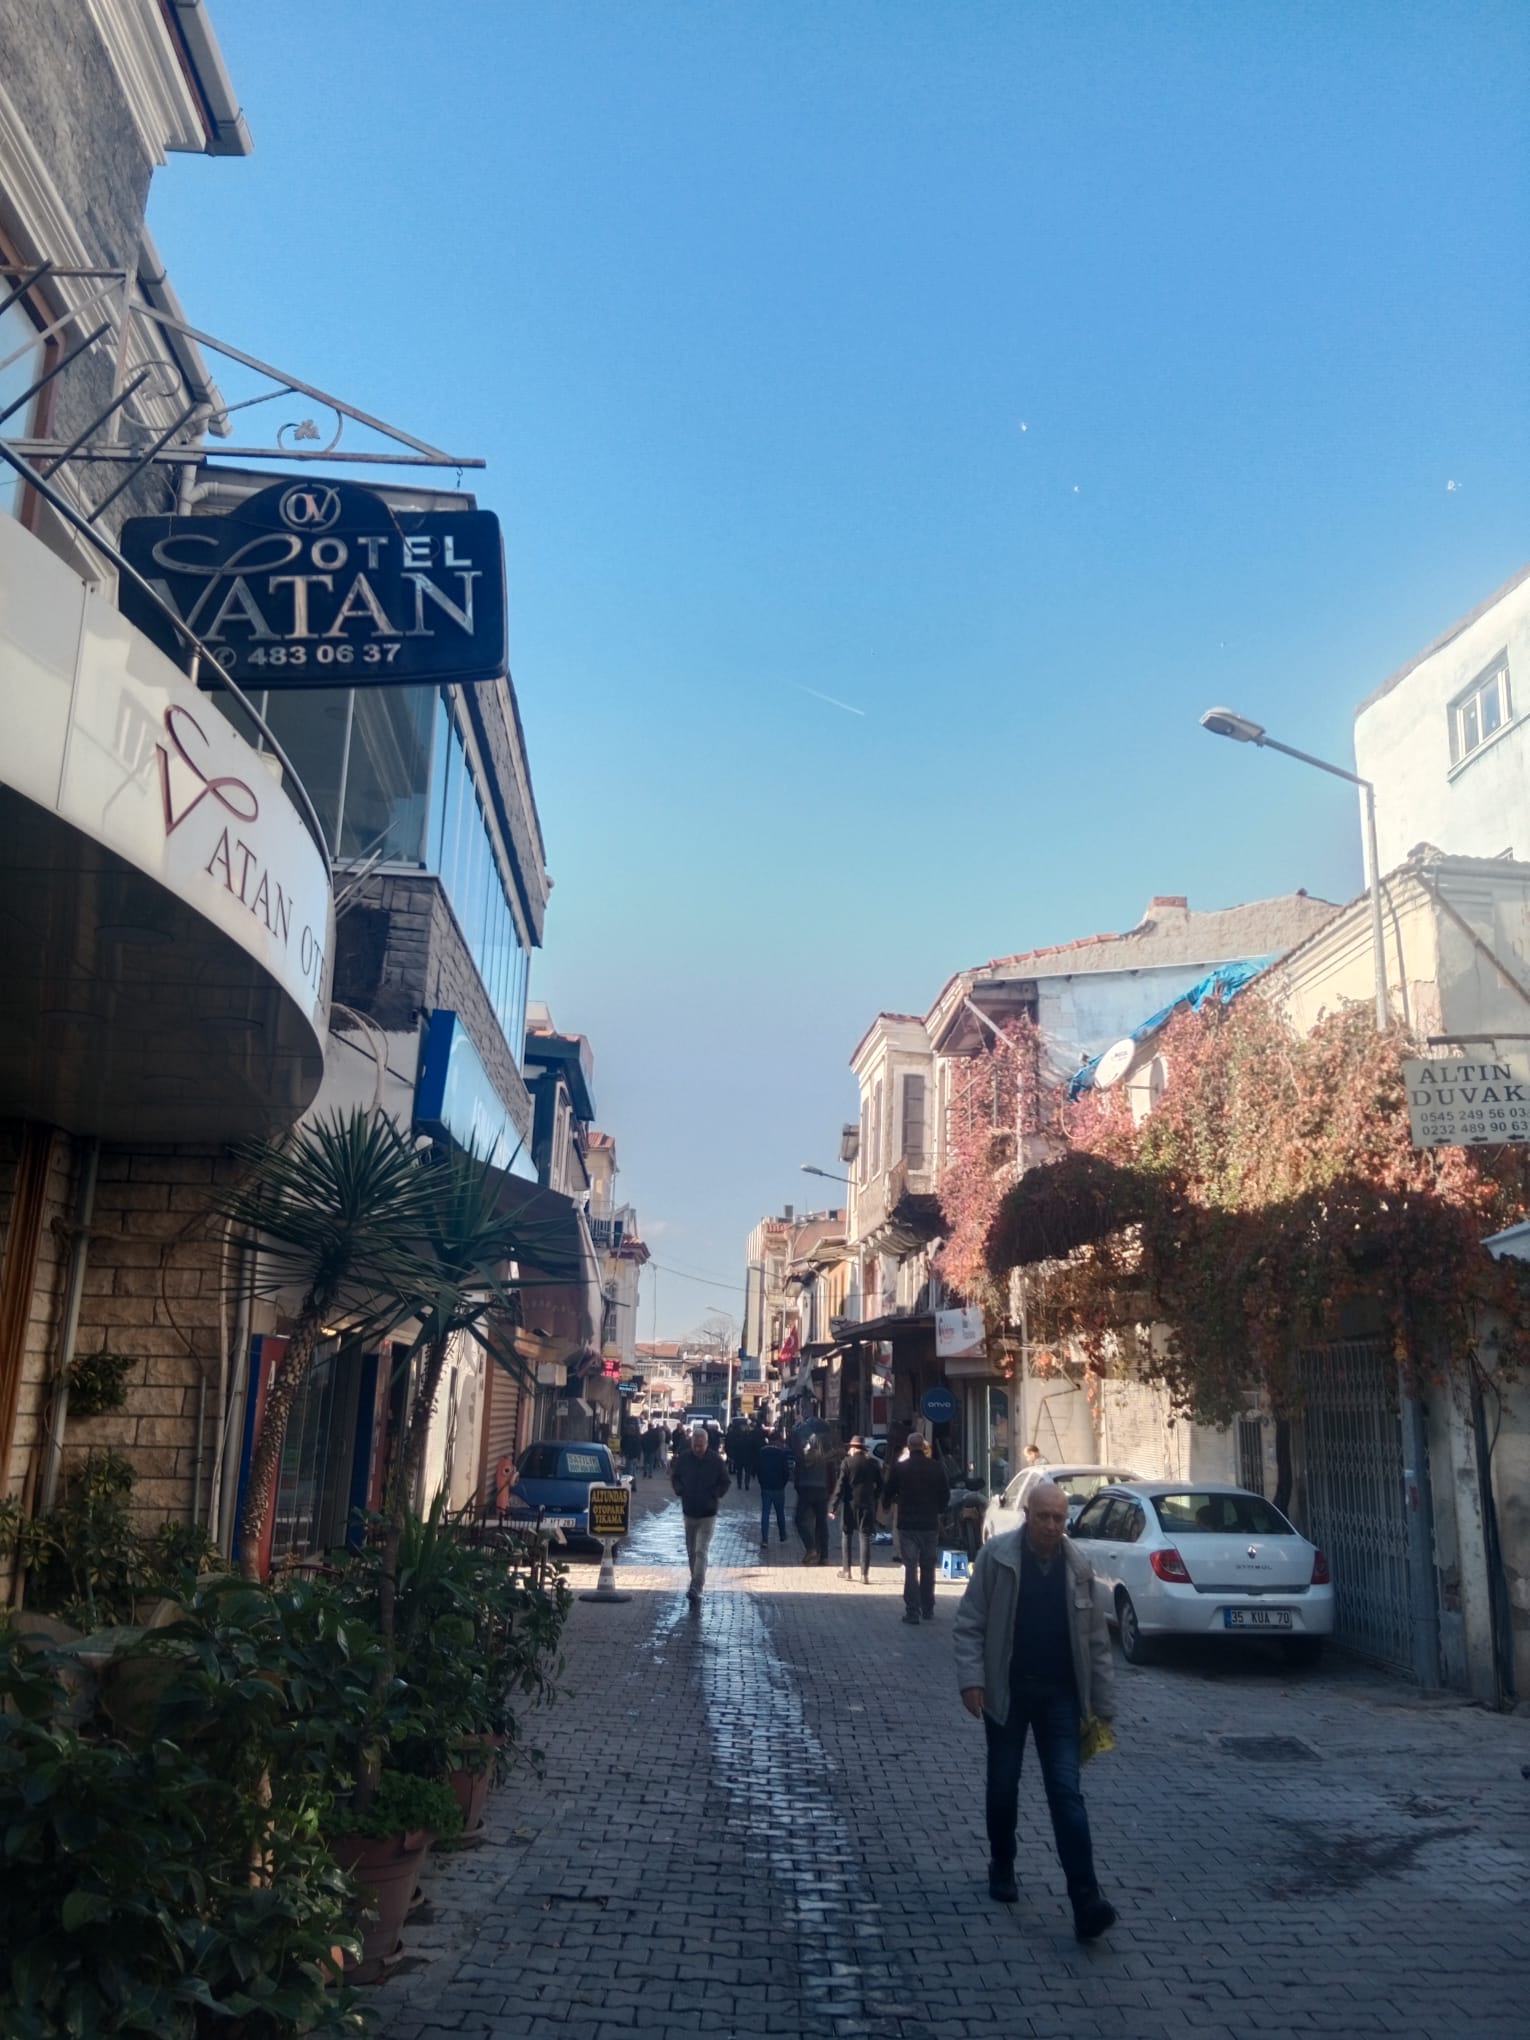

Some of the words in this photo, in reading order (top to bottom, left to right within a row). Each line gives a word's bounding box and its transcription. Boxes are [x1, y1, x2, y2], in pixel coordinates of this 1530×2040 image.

[311, 536, 473, 570] OTEL
[148, 533, 483, 640] VATAN
[247, 644, 307, 666] 483
[316, 643, 355, 665] 06
[362, 643, 401, 664] 37
[155, 704, 293, 950] VATAN
[1419, 1064, 1512, 1084] ALTIN
[1411, 1085, 1526, 1106] DUVAK
[1420, 1111, 1455, 1122] 0545
[1459, 1109, 1484, 1120] 249
[1488, 1108, 1506, 1119] 56
[1510, 1107, 1527, 1118] 03
[1422, 1124, 1456, 1136] 0232
[1461, 1122, 1486, 1134] 489
[1490, 1121, 1508, 1132] 90
[1511, 1120, 1529, 1131] 63
[1231, 1611, 1244, 1624] 35
[1250, 1611, 1271, 1624] KUA
[1277, 1611, 1290, 1625] 70
